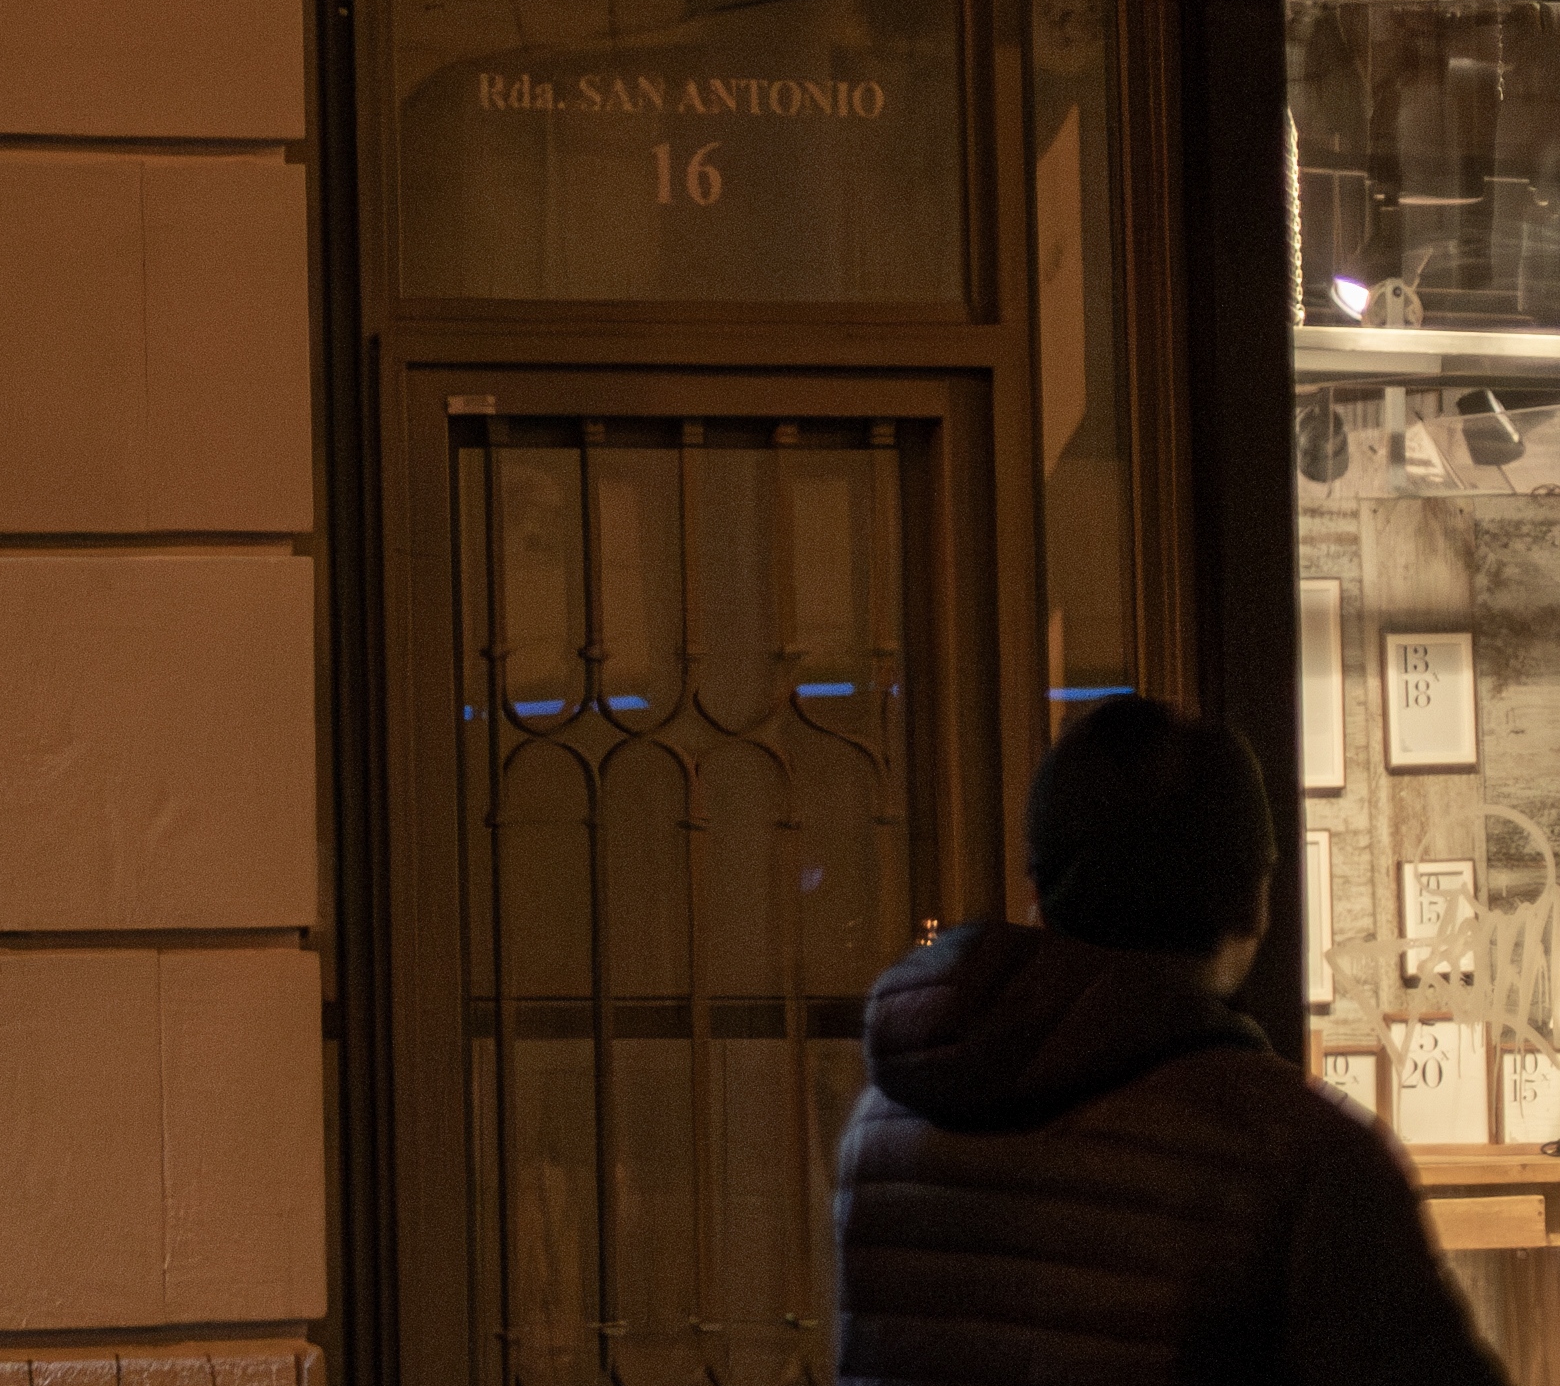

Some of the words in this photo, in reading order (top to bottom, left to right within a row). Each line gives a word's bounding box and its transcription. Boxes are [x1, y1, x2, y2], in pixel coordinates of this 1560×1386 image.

[578, 73, 666, 114] SAN
[678, 77, 886, 119] ANTONIO
[652, 142, 722, 206] 16
[1403, 645, 1430, 675] 13
[1403, 678, 1432, 709] 18
[1401, 1057, 1444, 1089] 20
[1510, 1051, 1539, 1075] 10
[1510, 1078, 1538, 1103] 15
